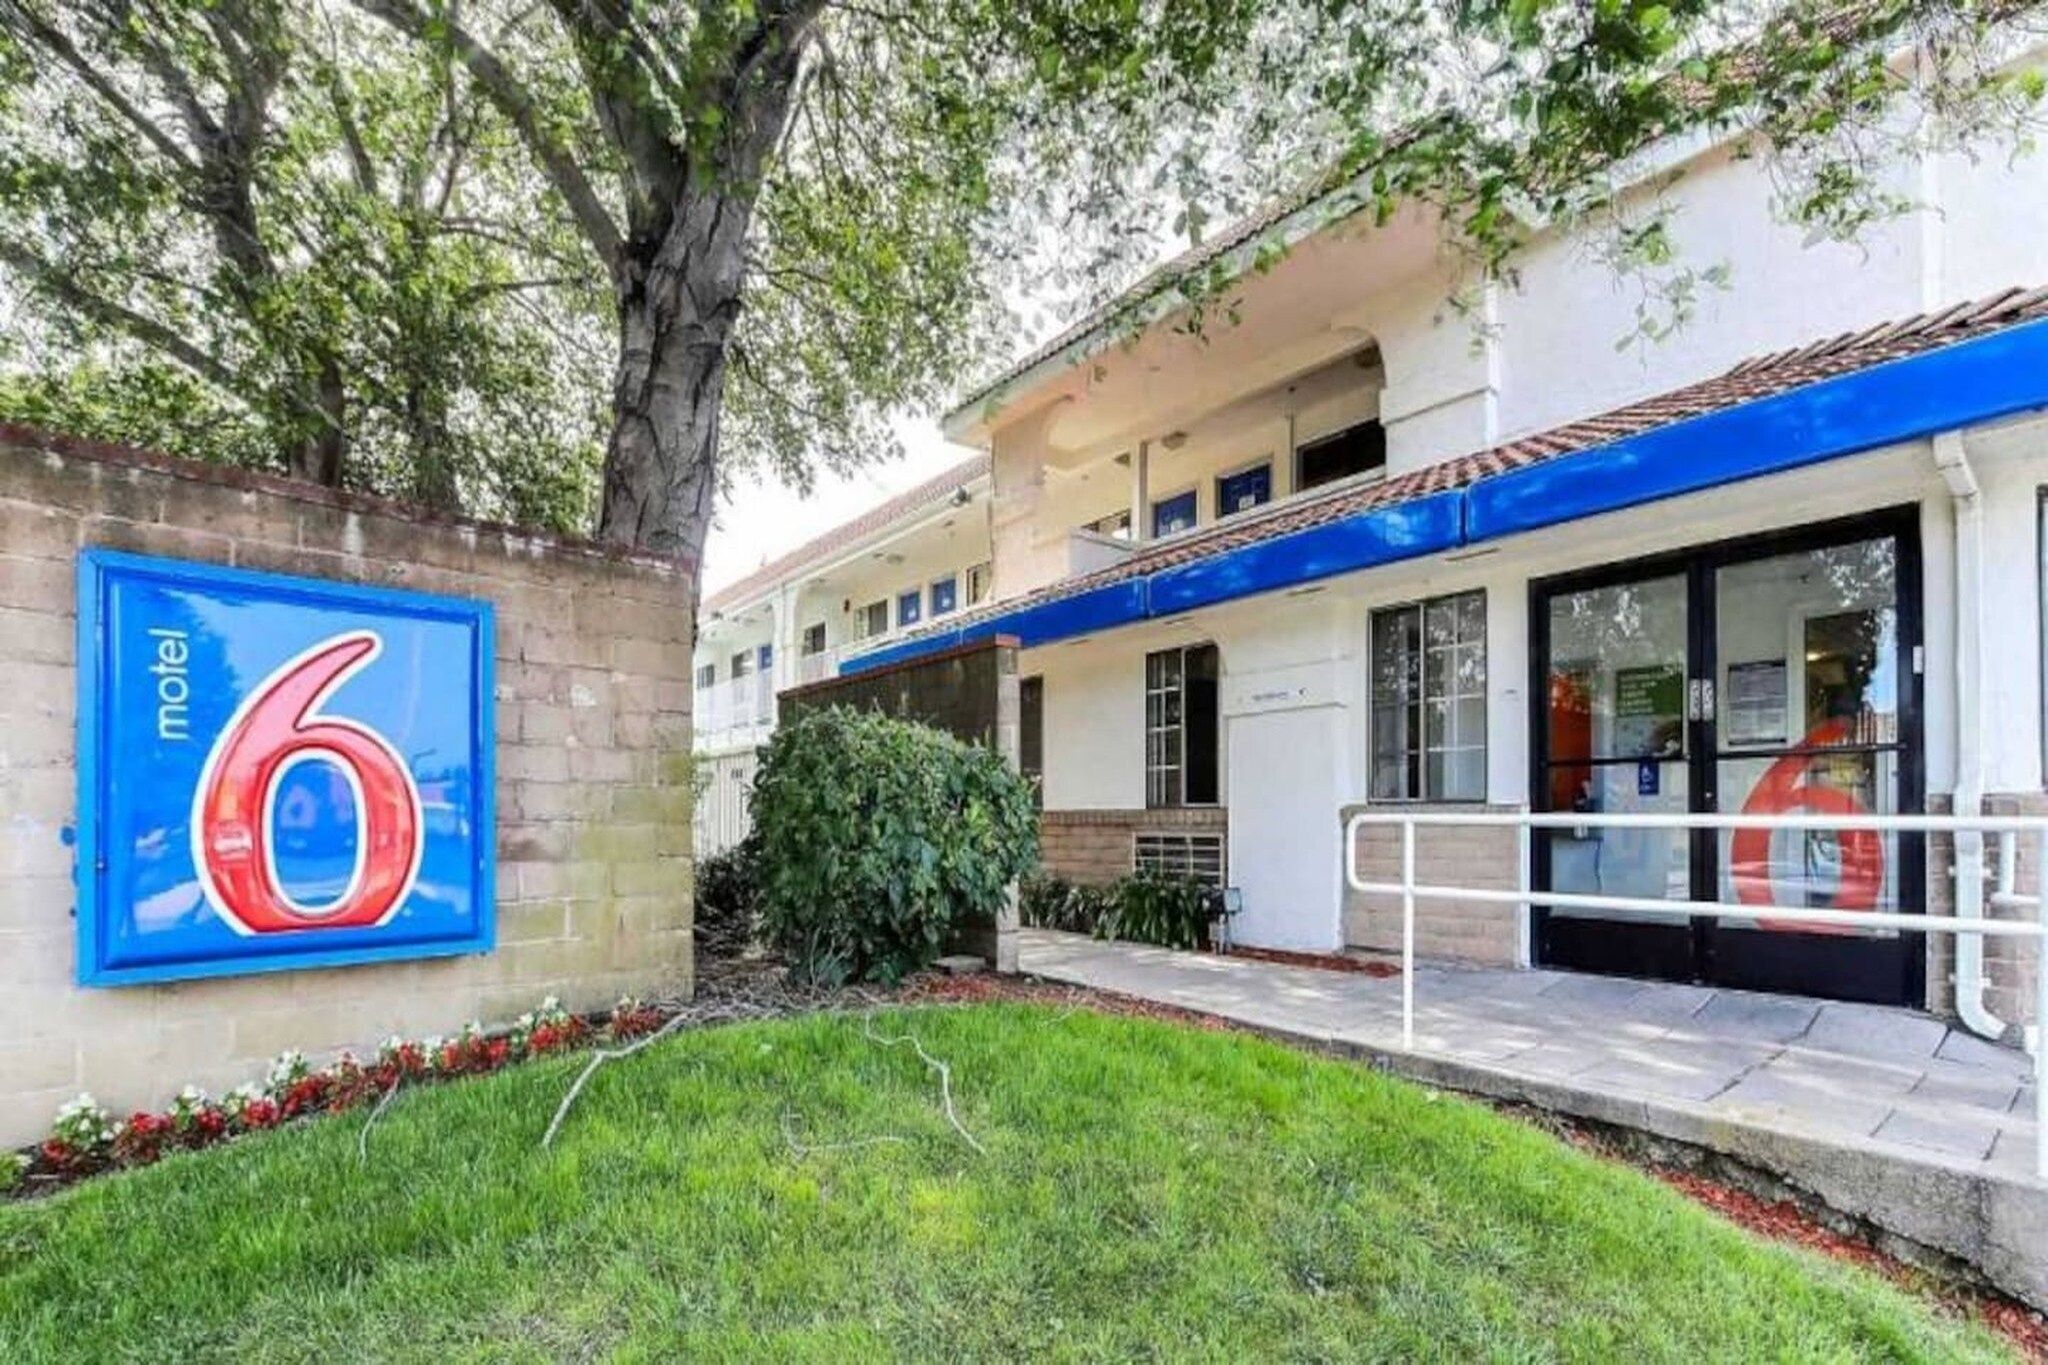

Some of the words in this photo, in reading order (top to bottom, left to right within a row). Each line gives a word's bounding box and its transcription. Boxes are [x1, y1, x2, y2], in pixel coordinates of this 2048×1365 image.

[147, 627, 190, 741] motel
[190, 629, 425, 937] 6
[1730, 716, 1885, 937] 6
